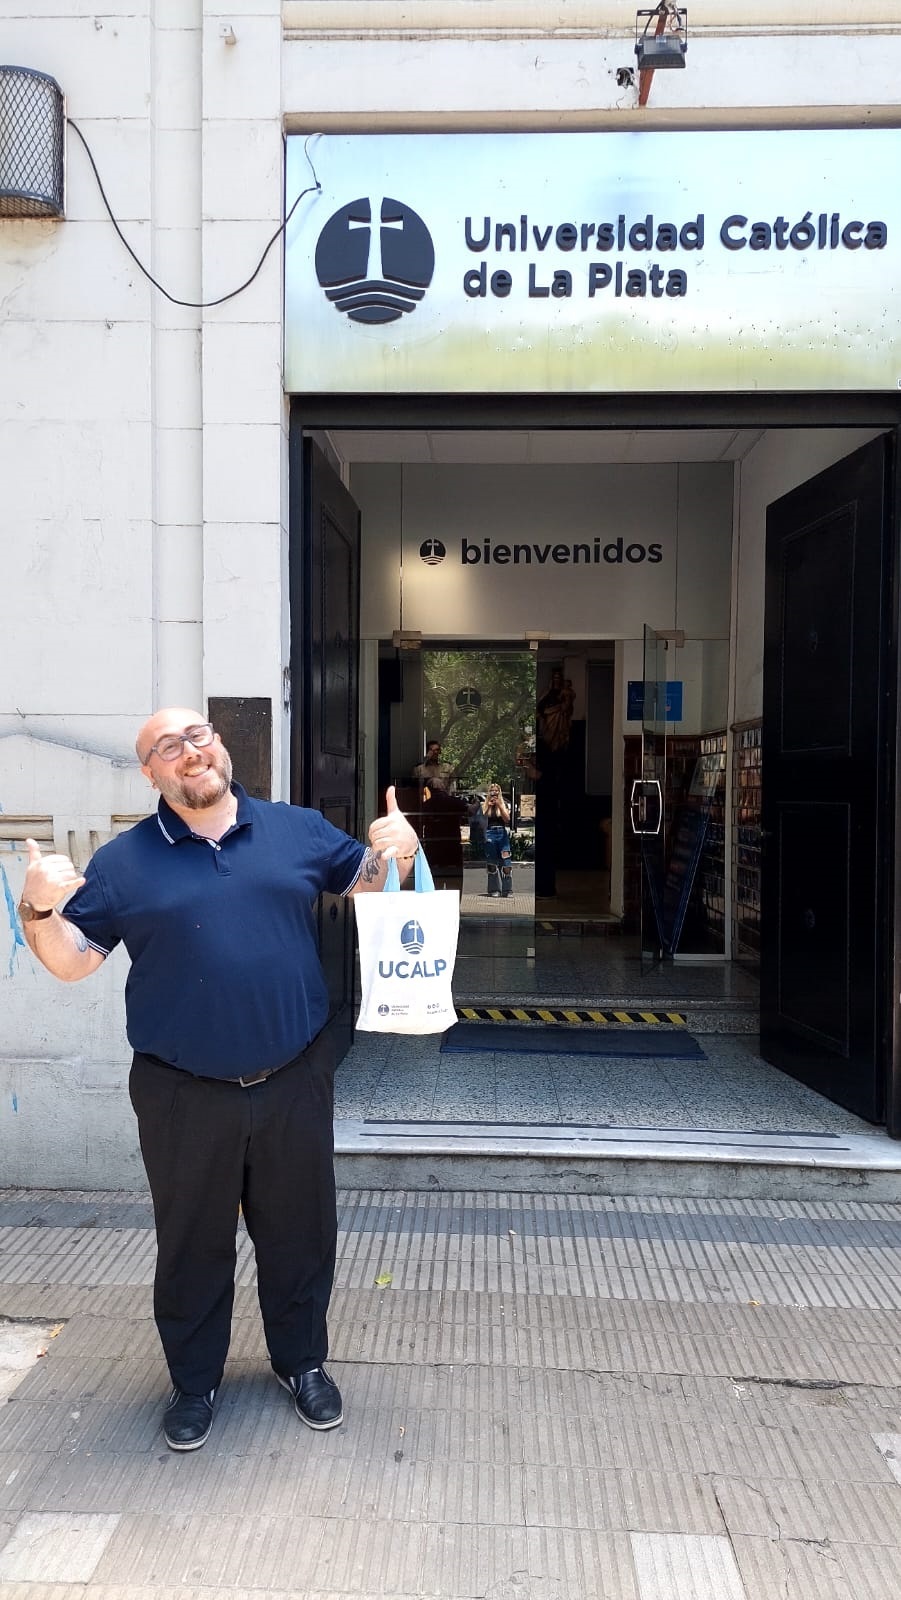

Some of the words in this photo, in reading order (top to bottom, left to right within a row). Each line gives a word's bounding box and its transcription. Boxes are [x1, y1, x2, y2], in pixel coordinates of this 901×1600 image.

[464, 214, 705, 252] Universidad
[720, 212, 888, 251] Católica
[463, 262, 513, 298] de
[528, 264, 573, 298] La
[588, 262, 688, 298] Plata
[461, 537, 663, 565] bienvenidos
[378, 959, 447, 979] UCALP
